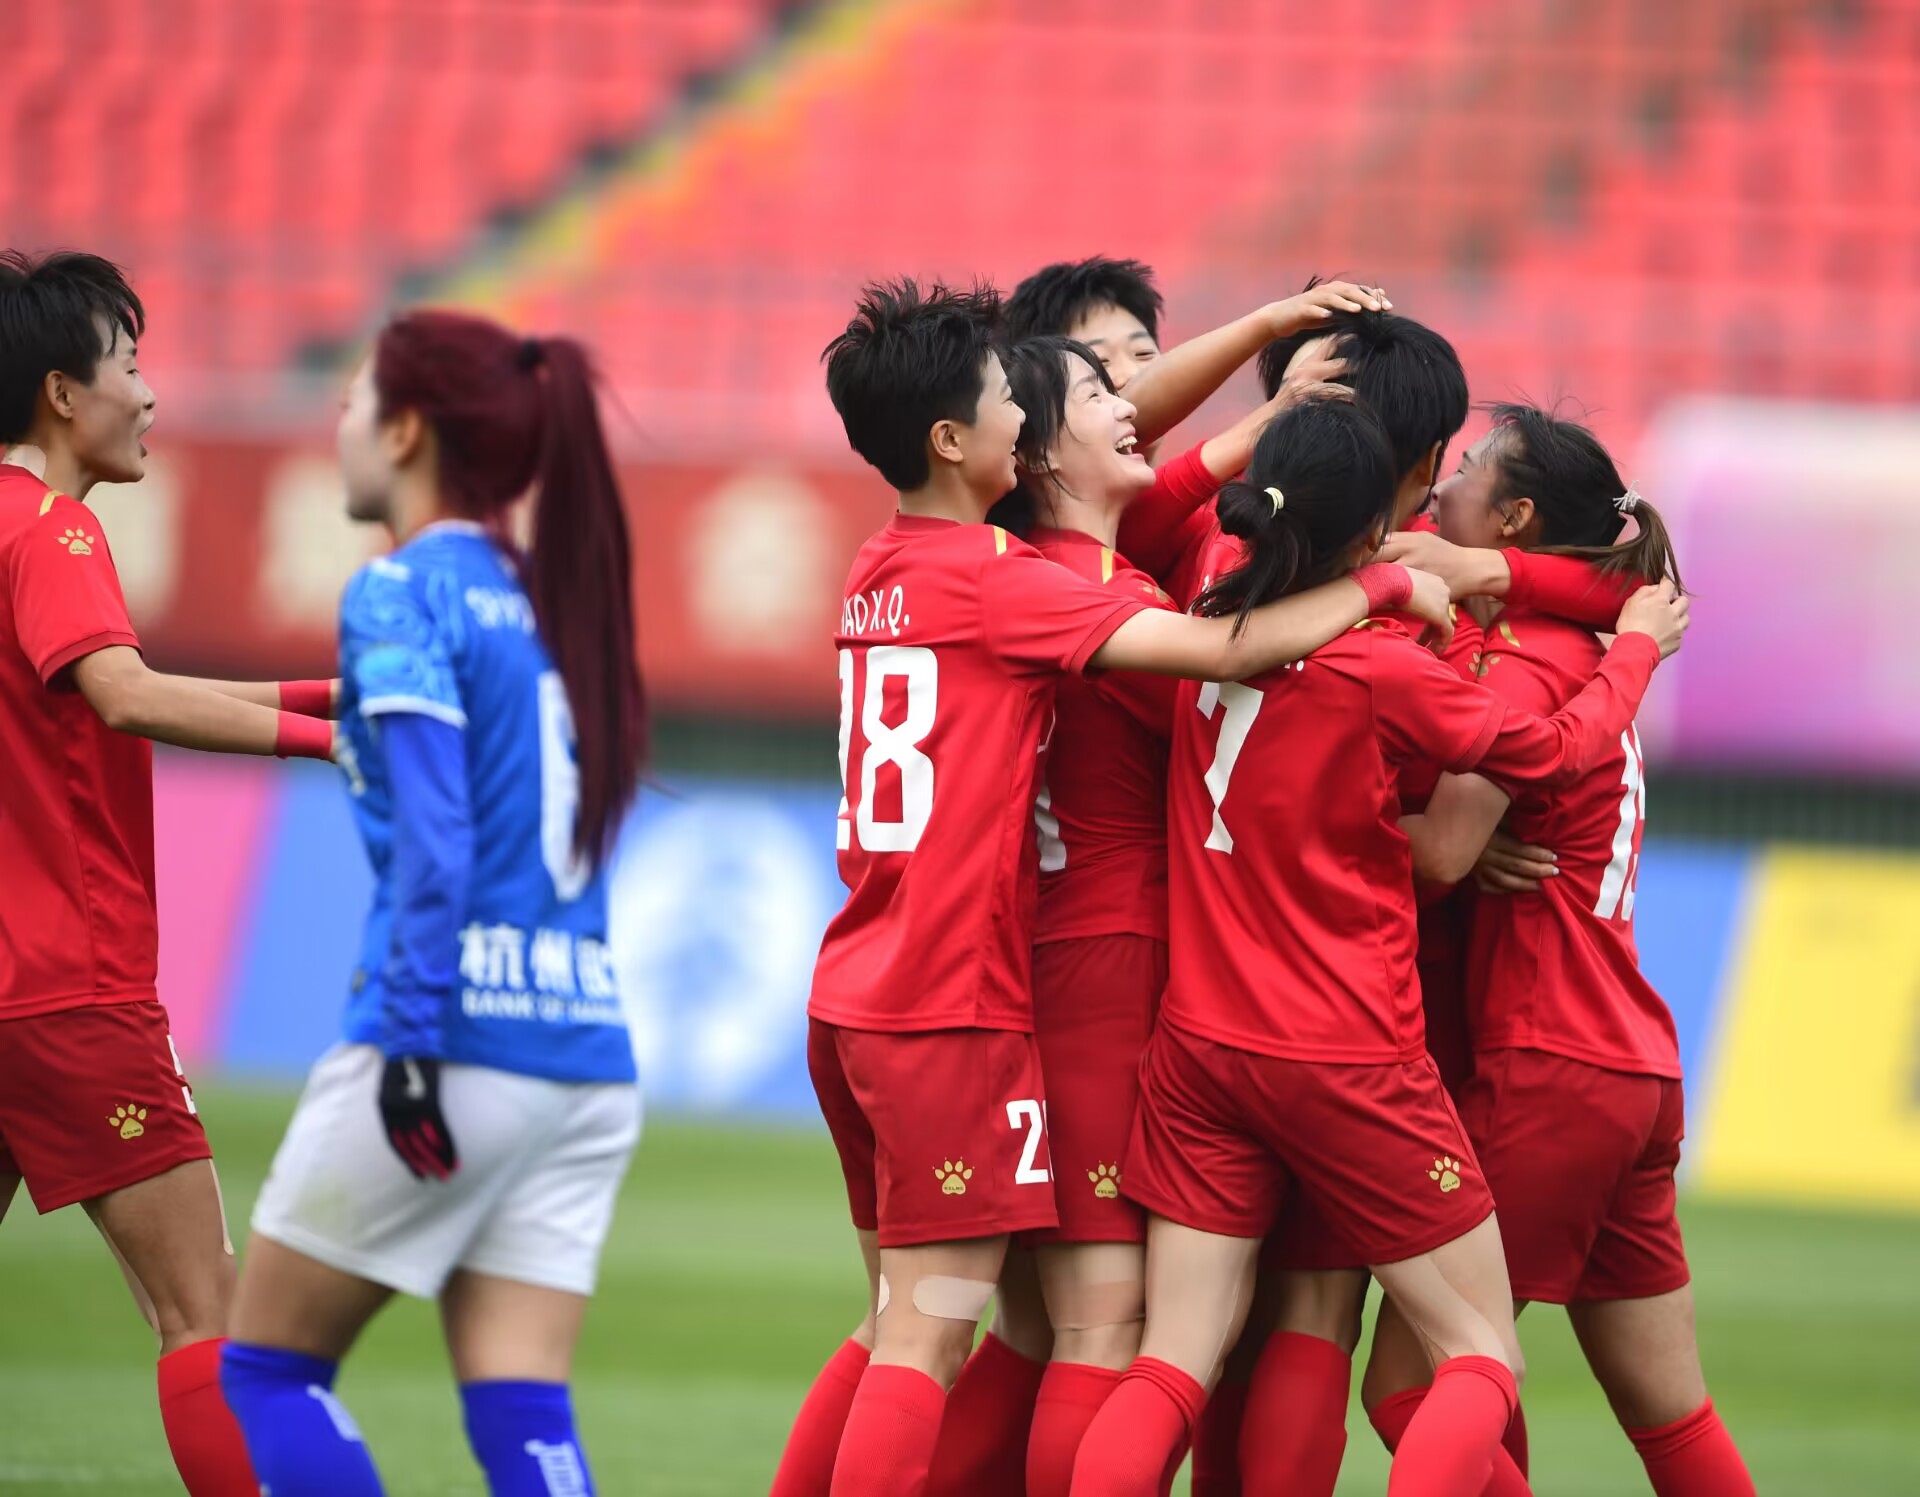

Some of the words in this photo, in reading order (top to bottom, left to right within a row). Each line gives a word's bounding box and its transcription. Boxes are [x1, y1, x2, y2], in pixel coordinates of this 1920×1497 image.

[841, 593, 868, 637] AO
[1197, 681, 1265, 855] 7
[1593, 720, 1646, 921] 1
[1006, 1099, 1054, 1185] 2
